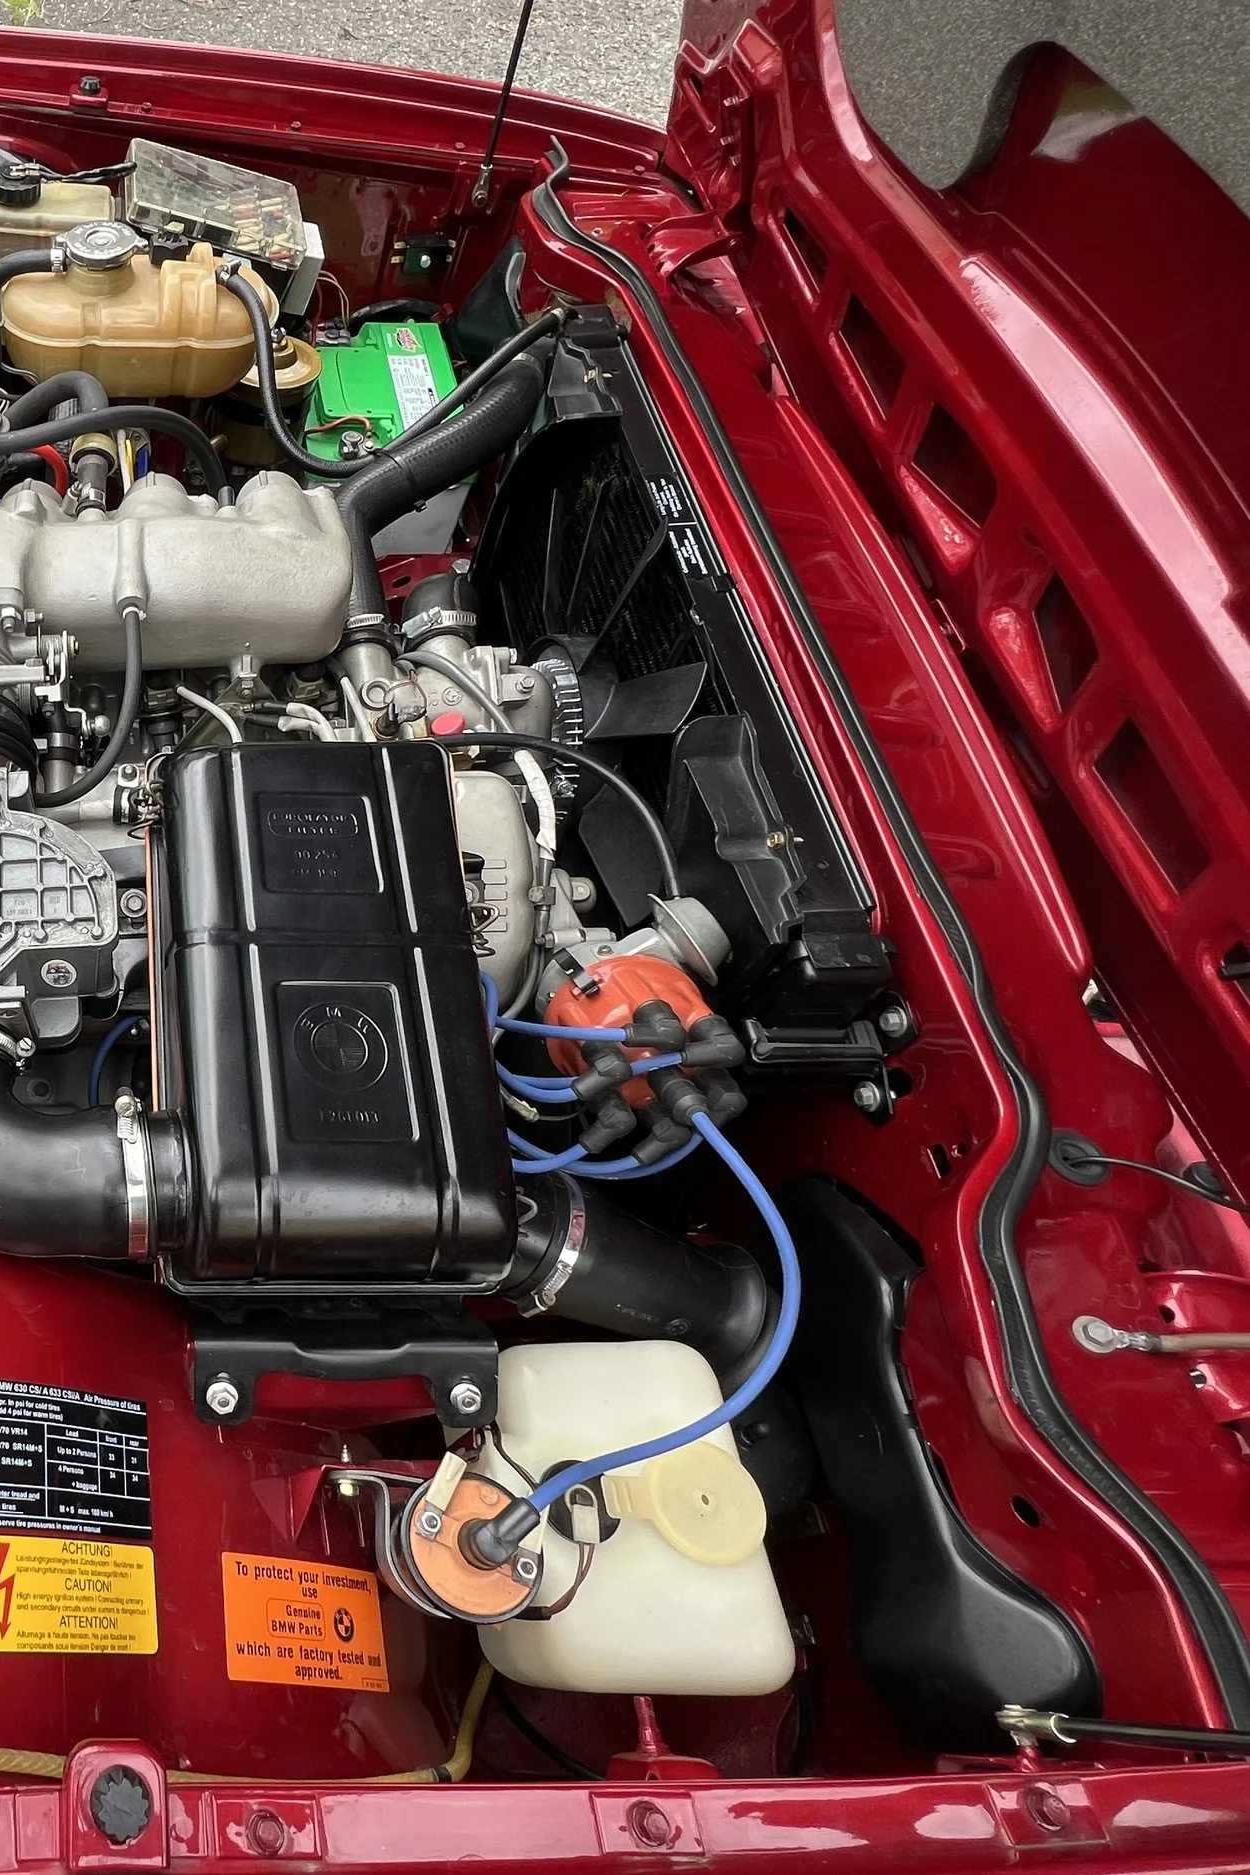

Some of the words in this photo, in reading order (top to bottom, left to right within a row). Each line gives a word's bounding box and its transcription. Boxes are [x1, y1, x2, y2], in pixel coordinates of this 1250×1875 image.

[14, 1383, 28, 1393] 630
[49, 1387, 62, 1398] 633
[84, 1394, 93, 1403] Air
[93, 1395, 120, 1408] Pressure
[120, 1400, 126, 1409] of
[127, 1401, 141, 1411] tires
[15, 1400, 25, 1409] psi
[25, 1400, 34, 1409] for
[35, 1402, 48, 1410] cold
[48, 1404, 61, 1412] tires
[7, 1407, 12, 1415] 4
[12, 1408, 22, 1417] psi
[23, 1409, 32, 1417] for
[32, 1411, 49, 1419] warm
[10, 1426, 29, 1436] VR14
[65, 1429, 79, 1438] Load
[57, 1446, 65, 1455] Up
[65, 1447, 72, 1455] to
[77, 1449, 97, 1459] Persons
[57, 1465, 62, 1473] 4
[62, 1466, 84, 1475] Persons
[76, 1481, 98, 1491] baggage
[11, 1490, 27, 1498] tread
[28, 1492, 40, 1500] and
[1, 1502, 16, 1511] tires
[16, 1519, 27, 1528] tire
[27, 1520, 55, 1529] pressures
[55, 1522, 62, 1530] in
[83, 1525, 101, 1533] manual
[61, 1541, 113, 1558] ACHTUNG!
[235, 1561, 248, 1576] To
[254, 1564, 294, 1581] protect
[297, 1570, 319, 1585] your
[322, 1571, 372, 1594] investment,
[64, 1577, 112, 1593] CAUTION!
[16, 1592, 31, 1602] High
[32, 1594, 54, 1602] energy
[54, 1593, 75, 1603] ignition
[97, 1595, 125, 1606] Connecting
[125, 1598, 144, 1607] primary
[301, 1587, 318, 1599] use
[16, 1603, 29, 1611] and
[30, 1603, 61, 1613] secondary
[61, 1604, 82, 1612] circuits
[82, 1605, 97, 1613] under
[97, 1606, 115, 1614] current
[120, 1607, 146, 1616] dangerous
[285, 1604, 321, 1620] Genuine
[59, 1615, 119, 1630] ATTENTION!
[271, 1620, 296, 1634] BMW
[299, 1624, 323, 1637] Parts
[16, 1630, 46, 1640] Allumage
[99, 1633, 109, 1641] pas
[236, 1641, 271, 1657] which
[276, 1646, 294, 1659] are
[299, 1645, 334, 1665] factory
[338, 1649, 364, 1665] tested
[367, 1653, 382, 1667] and
[294, 1664, 343, 1680] approved.
